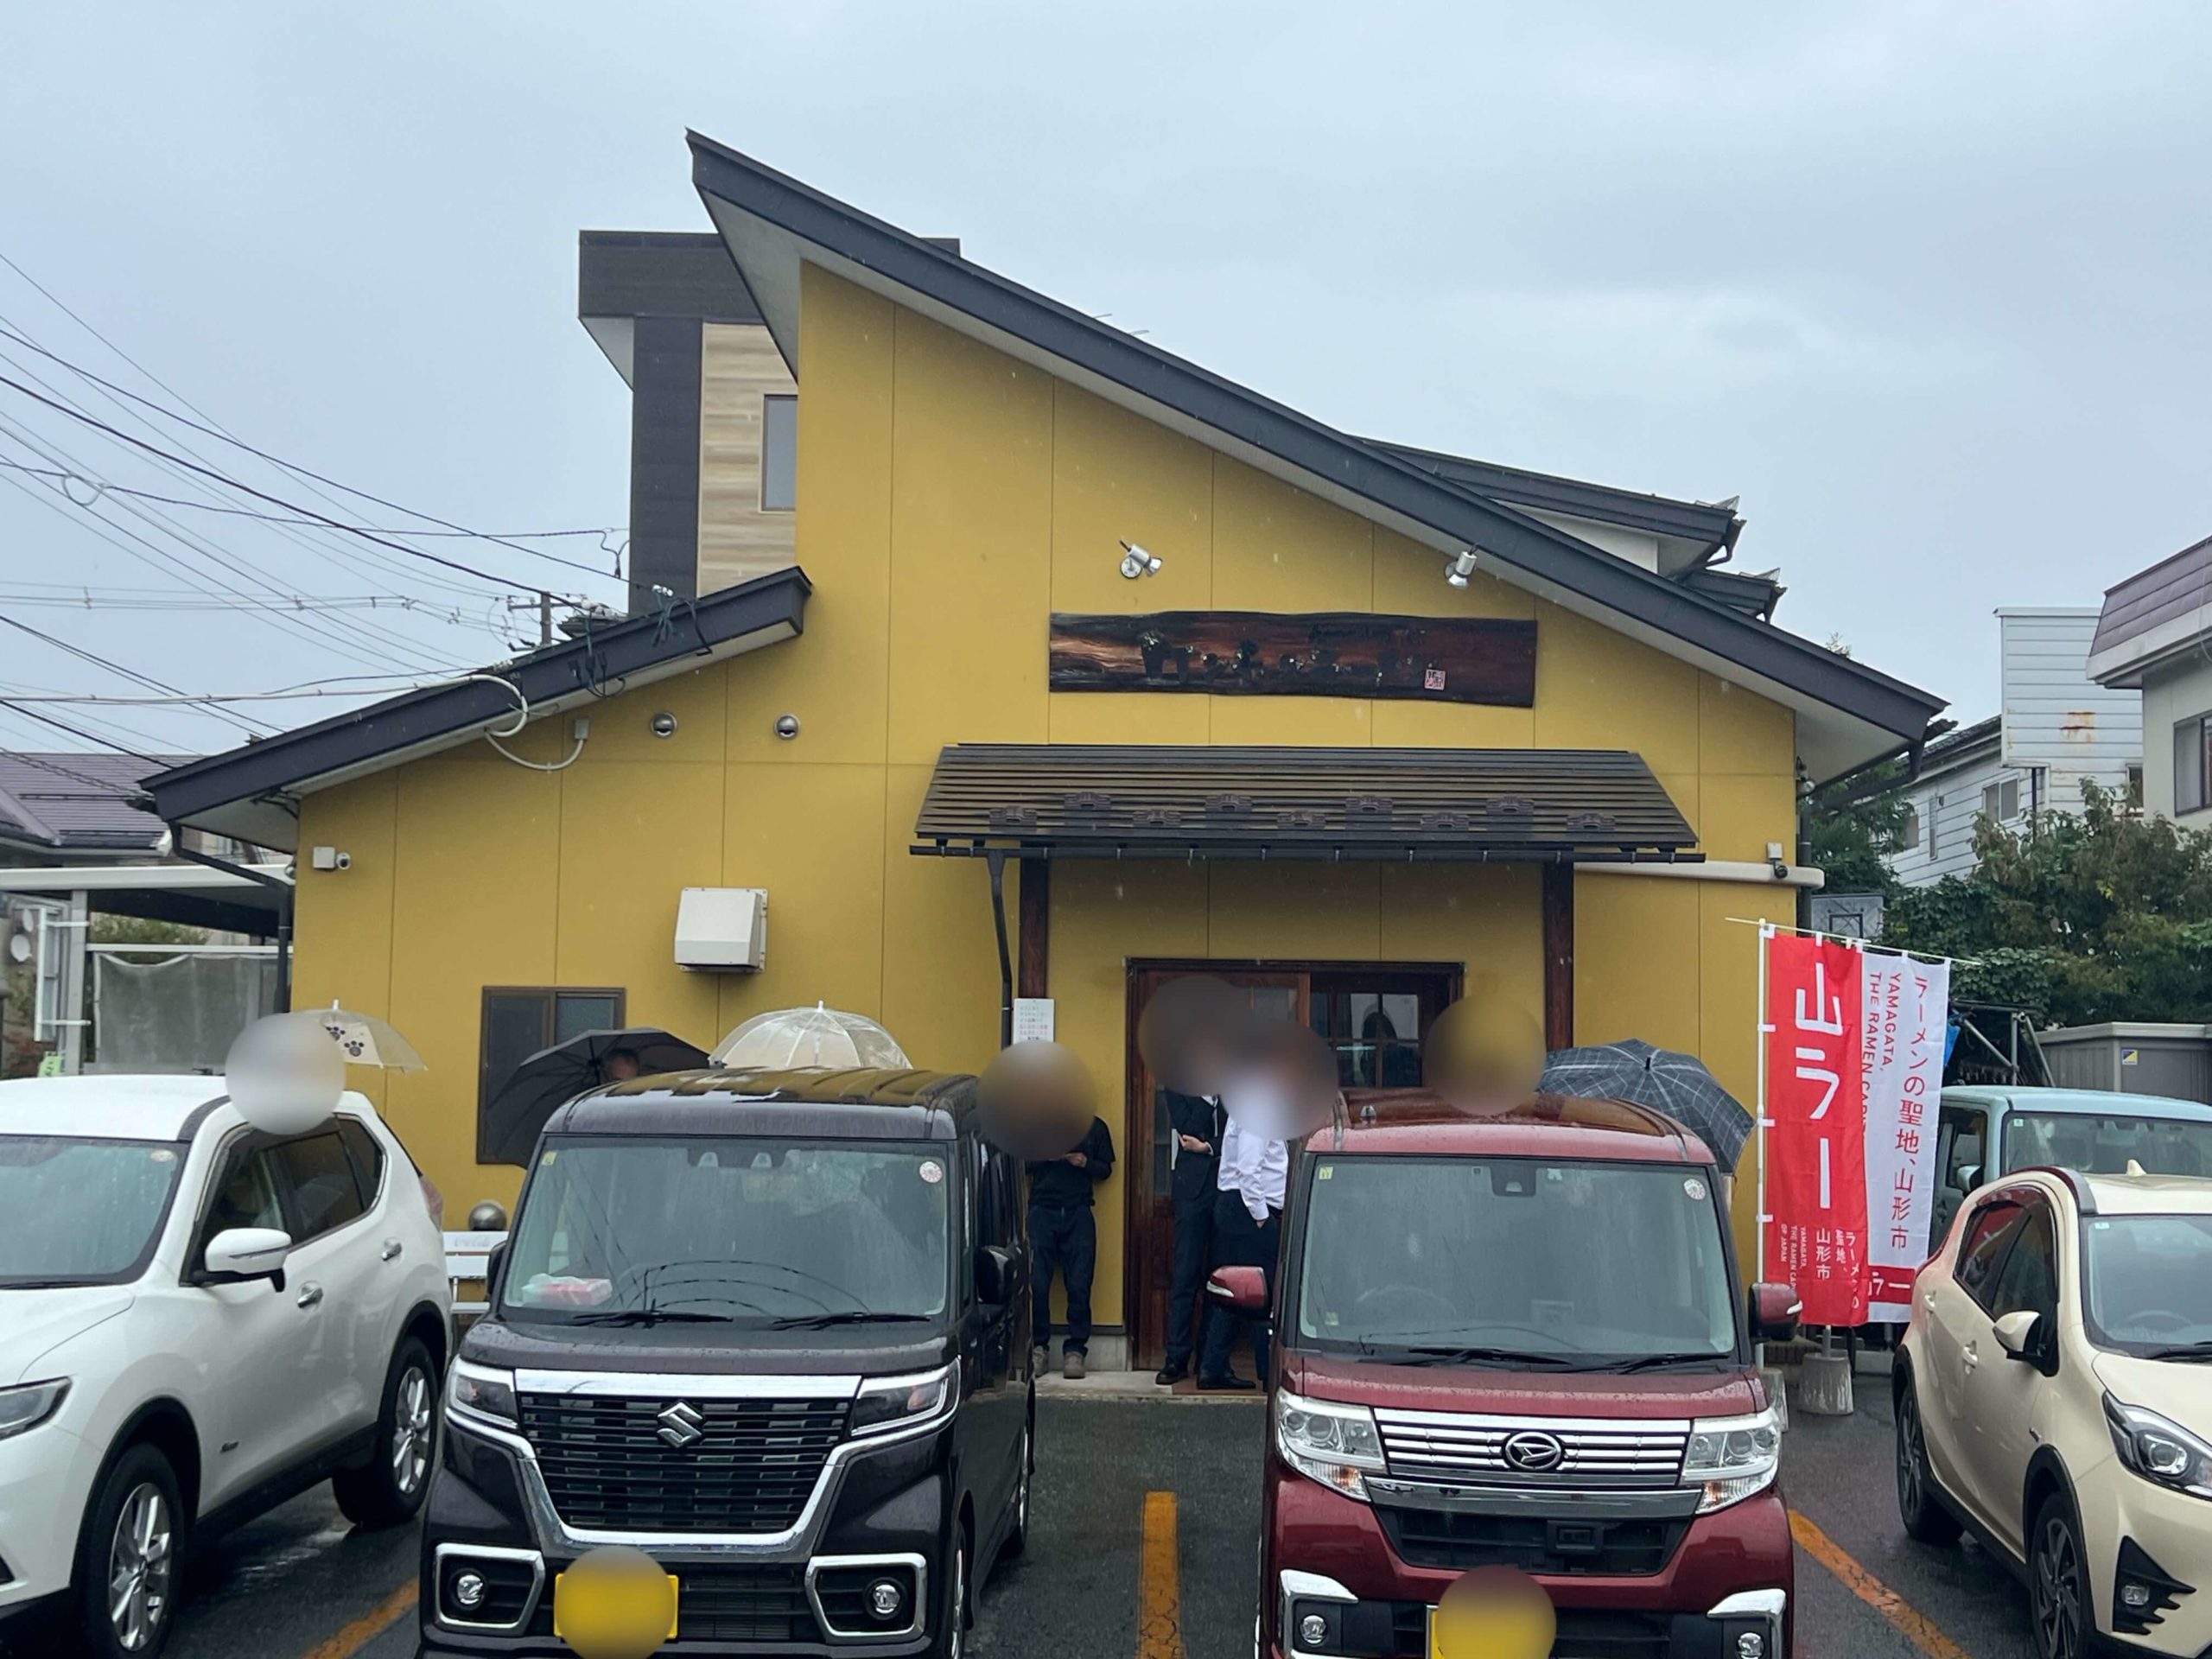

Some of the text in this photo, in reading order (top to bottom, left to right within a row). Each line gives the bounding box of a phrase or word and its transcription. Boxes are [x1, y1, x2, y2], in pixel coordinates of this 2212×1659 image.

[1869, 972, 1882, 1006] THE
[1862, 1012, 1879, 1074] RAMEN
[1880, 973, 1902, 1071] YAMAGATA,
[1795, 962, 1843, 1209] 山ラー
[1891, 976, 1929, 1250] ラーメンの聖地、山形市
[1780, 1224, 1788, 1235] OF
[1815, 1227, 1832, 1281] 山形市
